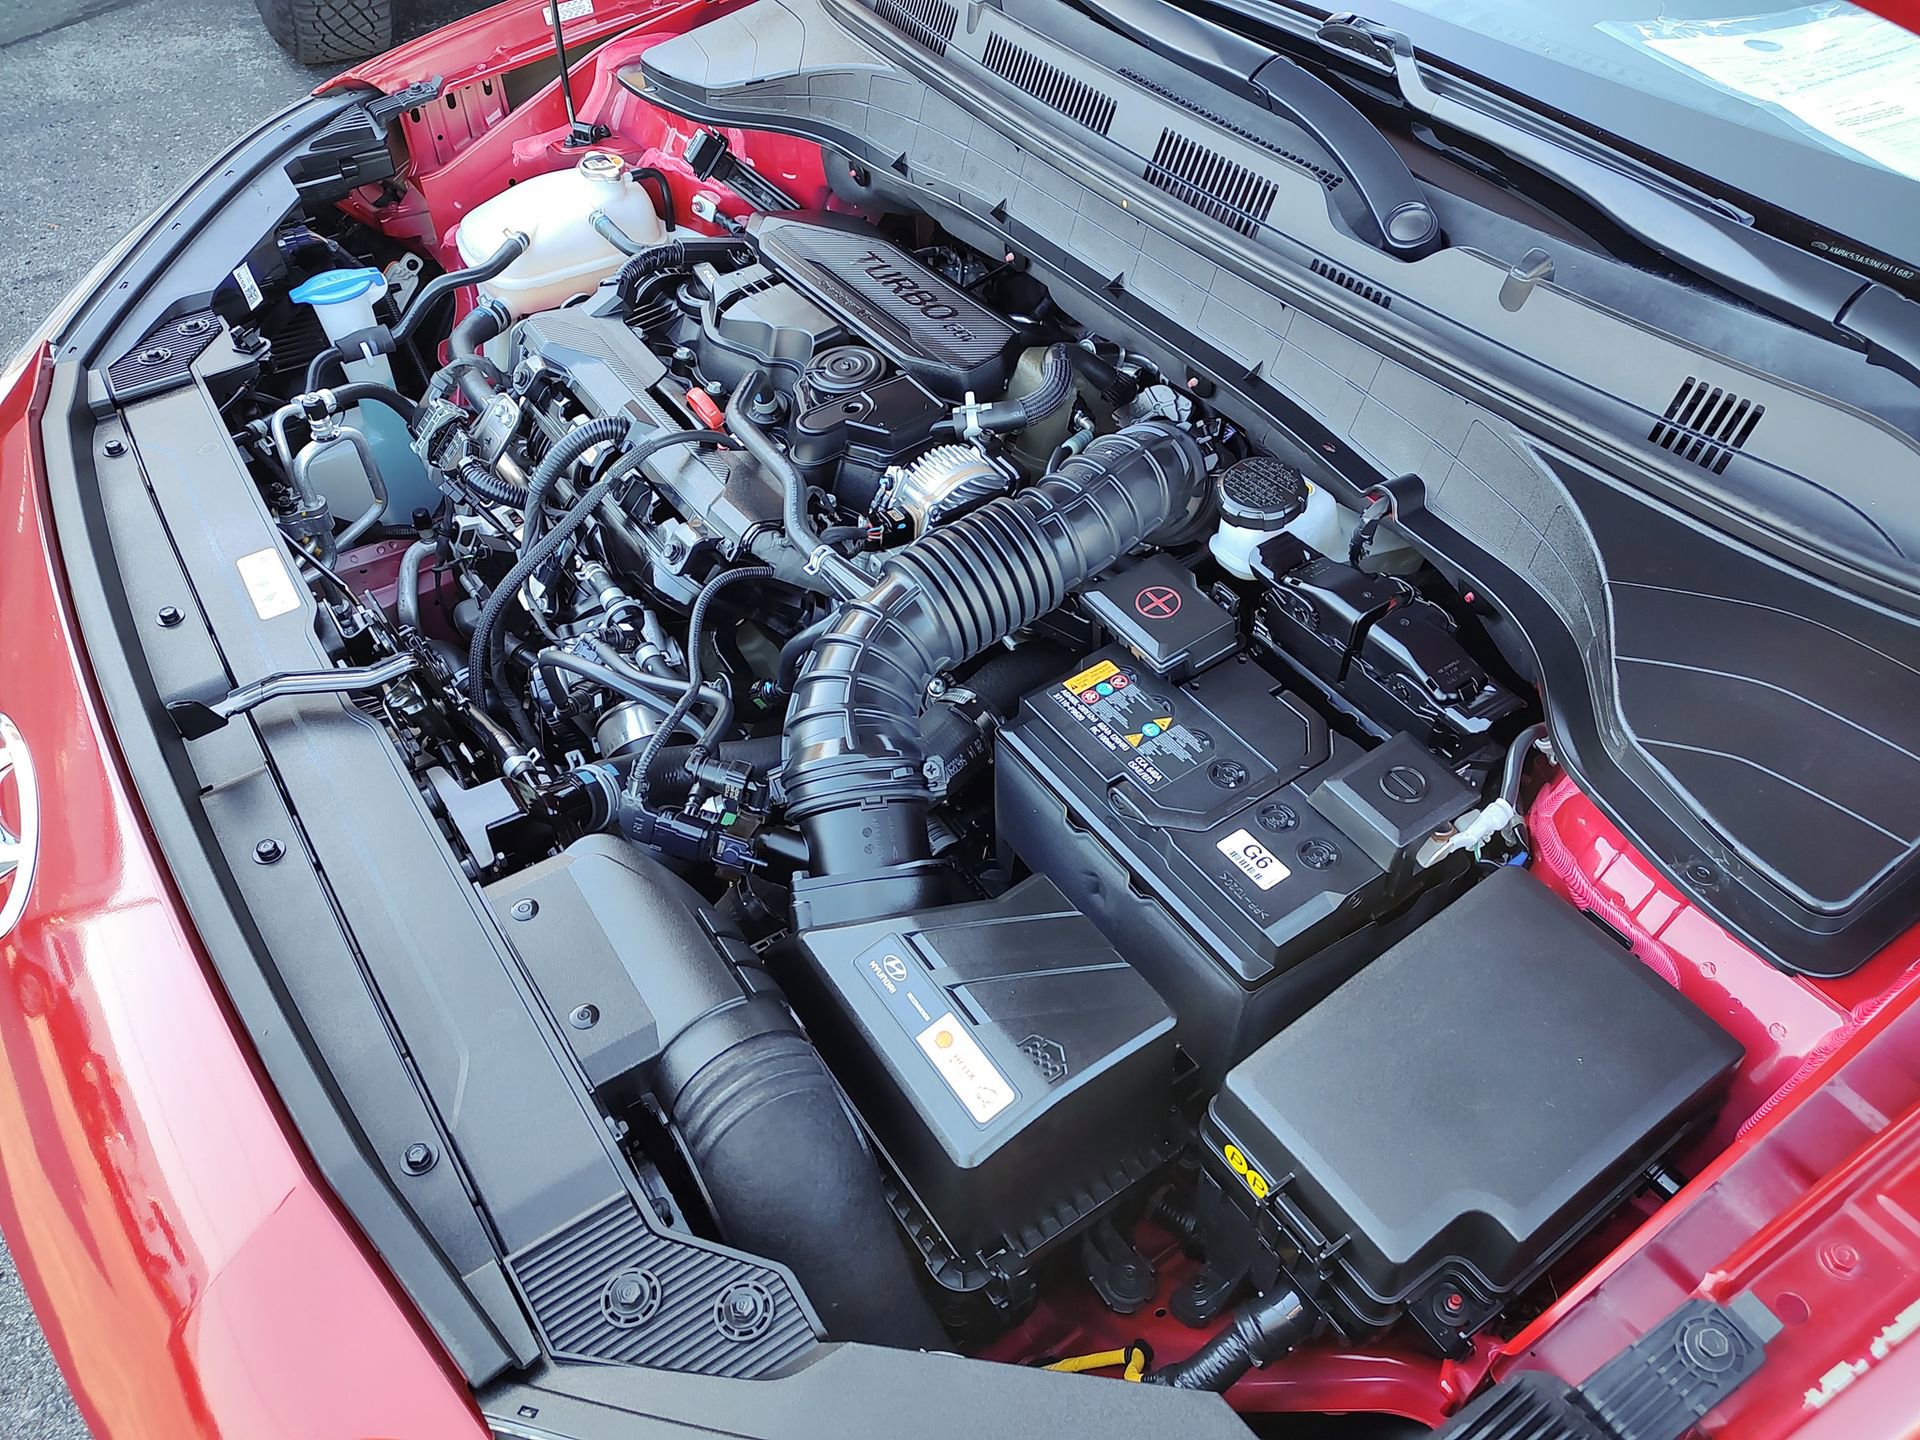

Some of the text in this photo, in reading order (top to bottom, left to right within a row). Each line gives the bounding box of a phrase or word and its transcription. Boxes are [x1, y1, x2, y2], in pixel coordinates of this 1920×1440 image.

[852, 250, 959, 320] TURBO
[1134, 756, 1147, 769] CCA
[1242, 844, 1273, 869] G6
[868, 959, 897, 994] HYUNDAI
